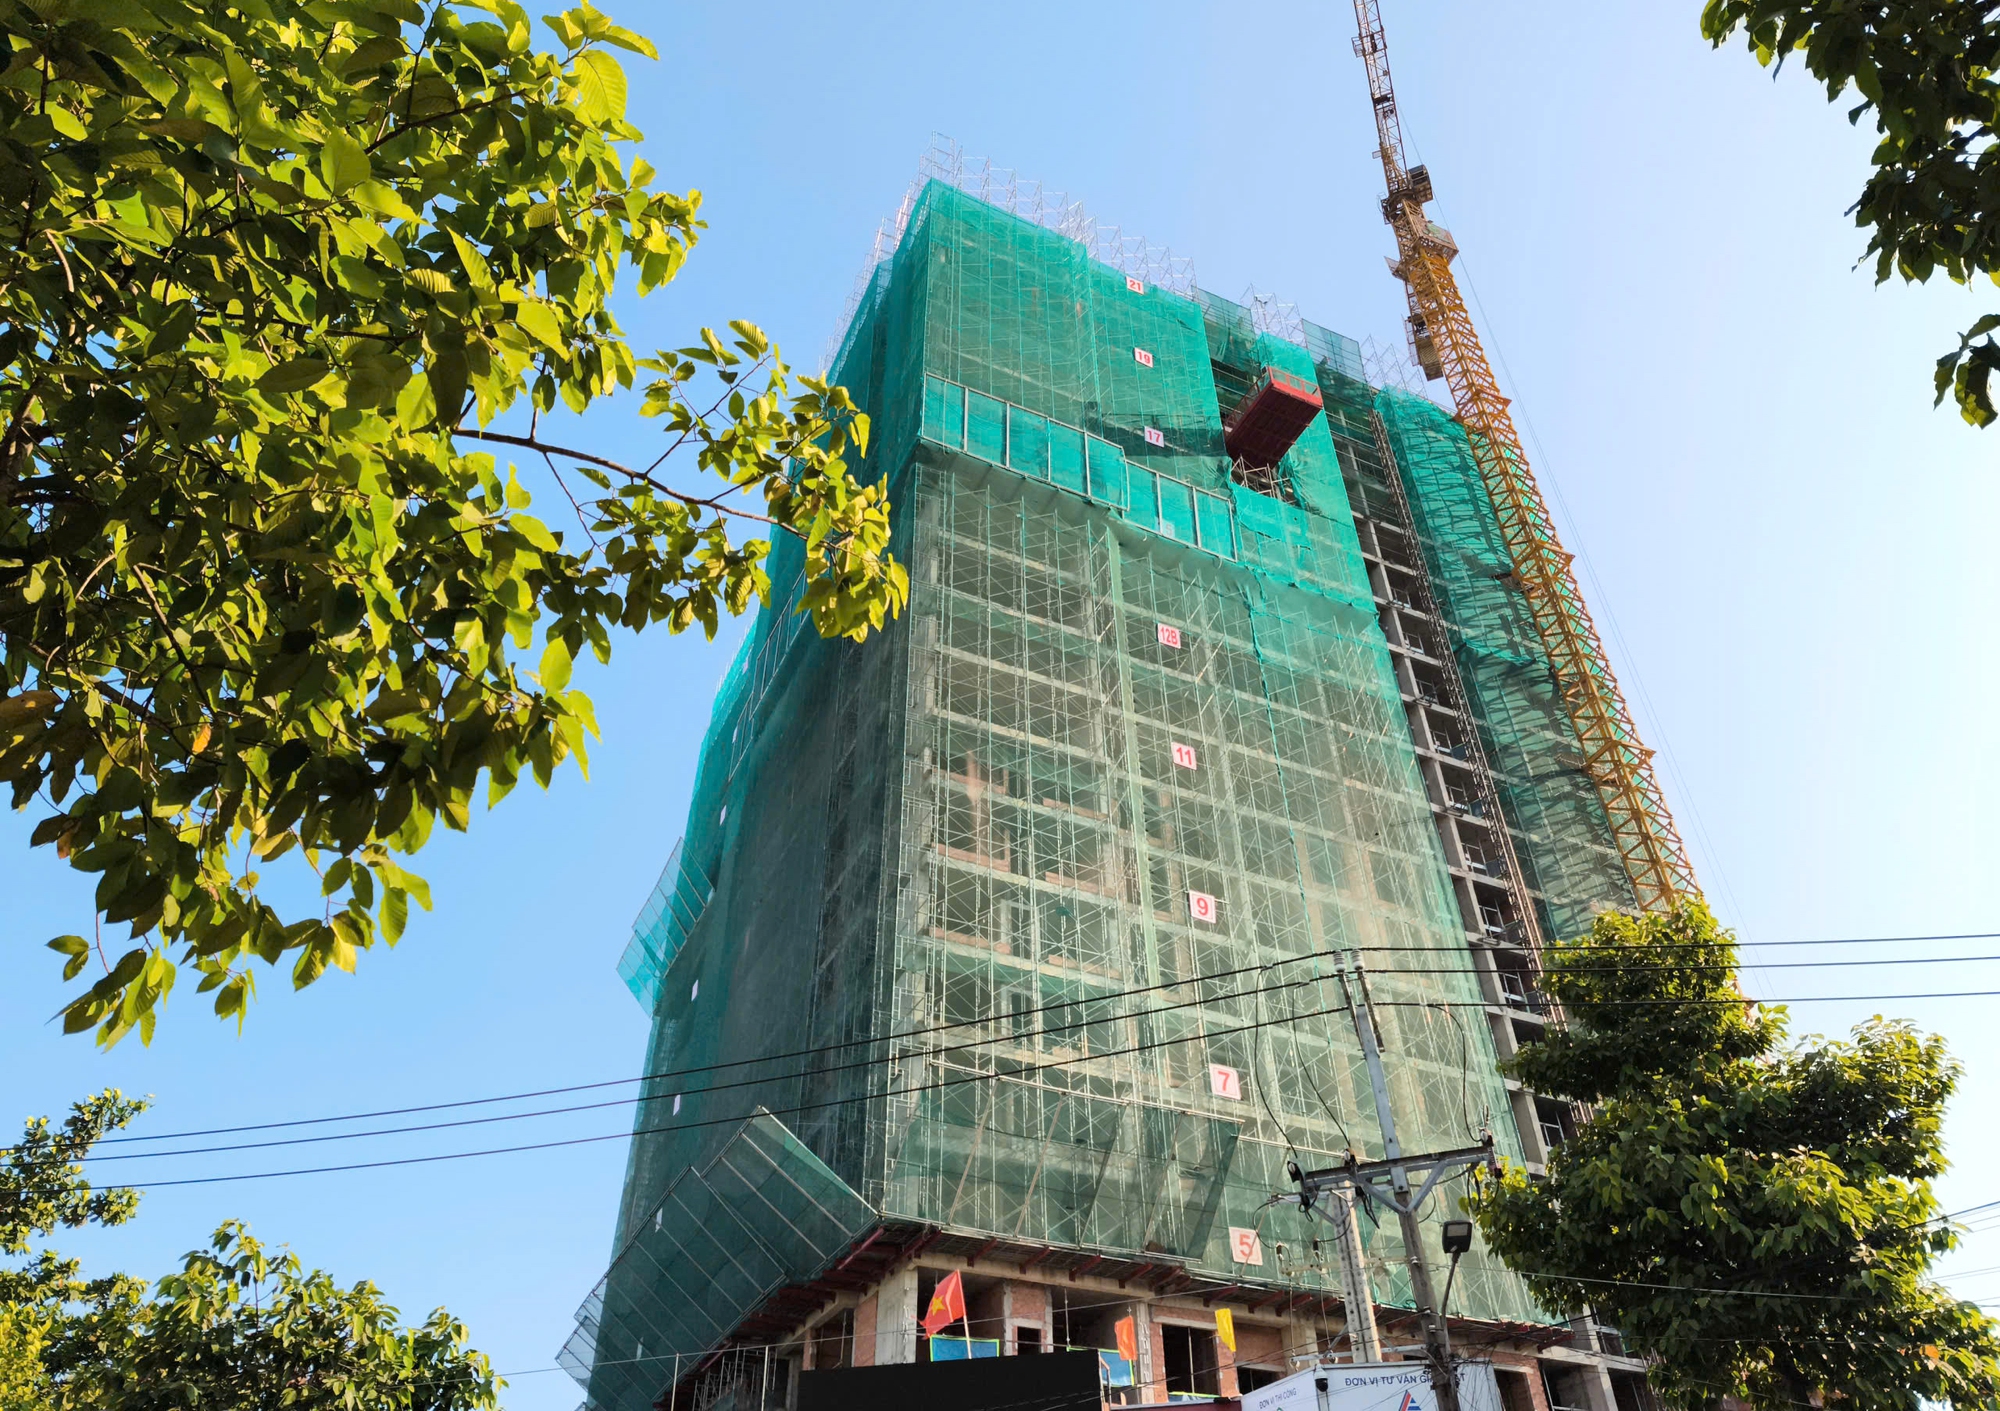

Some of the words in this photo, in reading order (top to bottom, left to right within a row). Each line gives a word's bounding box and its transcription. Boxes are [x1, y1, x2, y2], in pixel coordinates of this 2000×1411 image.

[1129, 279, 1141, 291] 21
[1137, 351, 1151, 364] 19
[1147, 430, 1161, 443] 17
[1160, 626, 1178, 646] 12B
[1176, 747, 1192, 766] 11
[1196, 898, 1209, 916] 9
[1217, 1071, 1231, 1092] 7
[1239, 1234, 1253, 1258] 5
